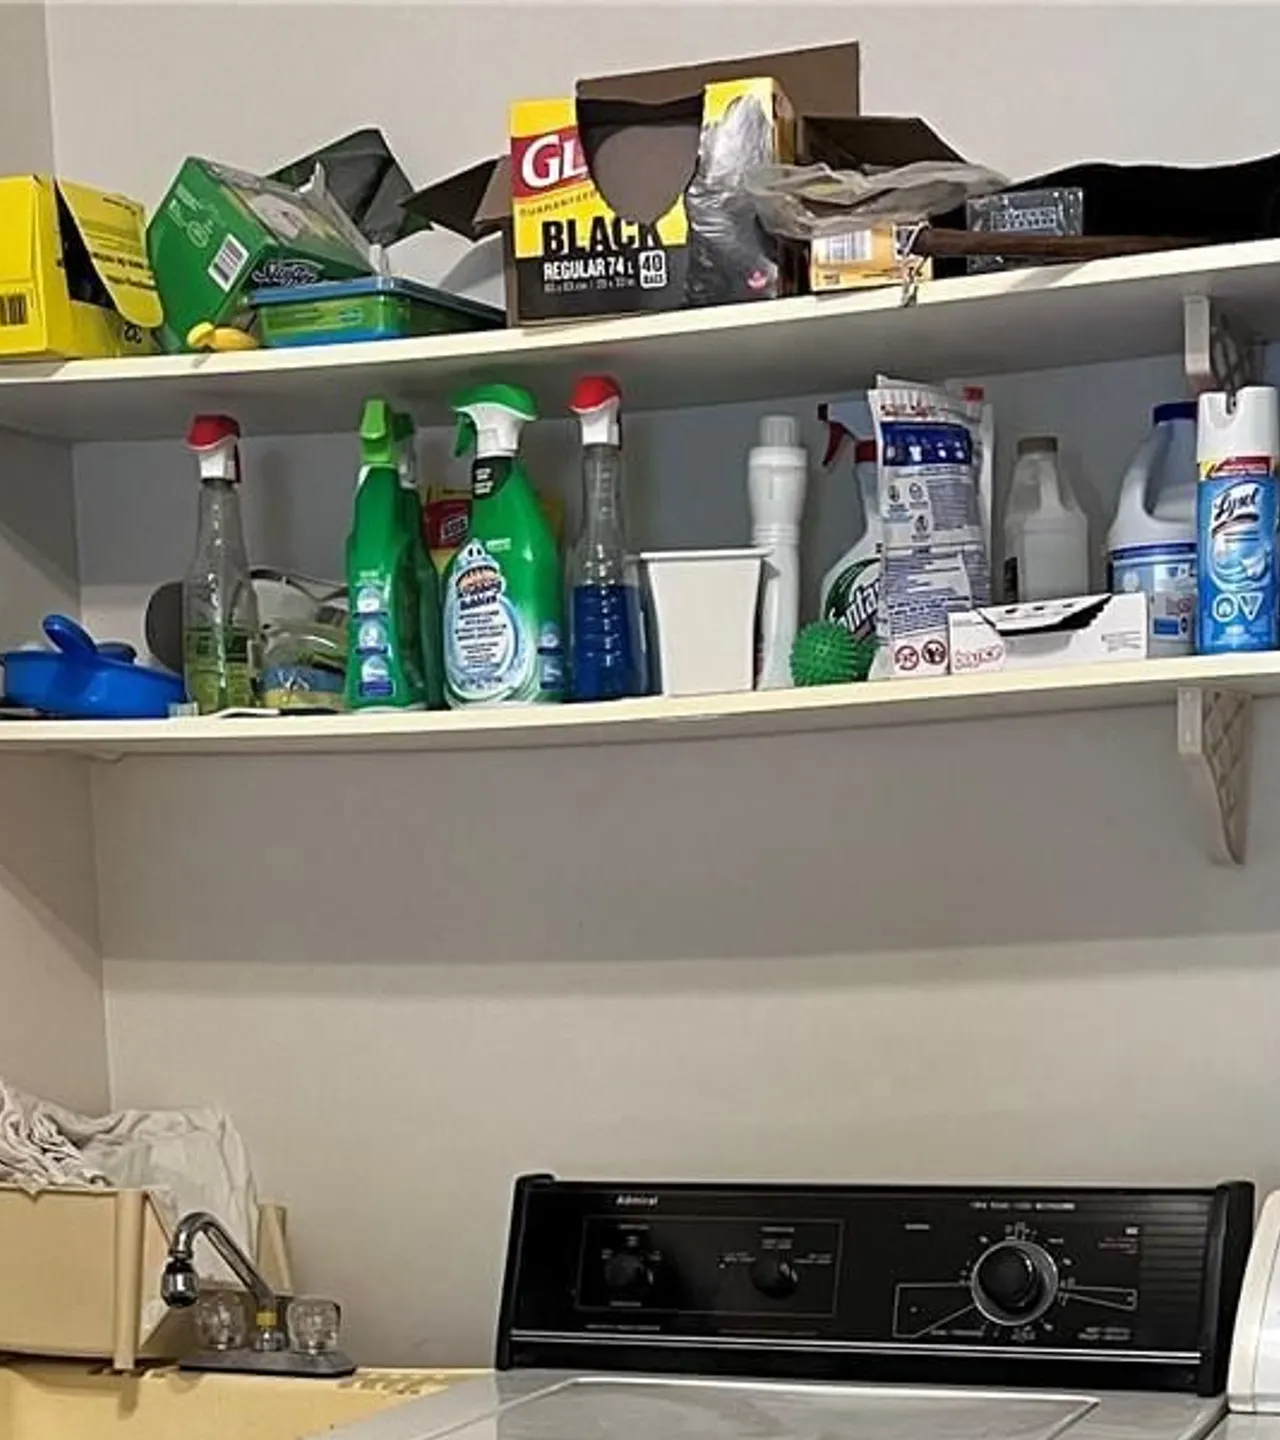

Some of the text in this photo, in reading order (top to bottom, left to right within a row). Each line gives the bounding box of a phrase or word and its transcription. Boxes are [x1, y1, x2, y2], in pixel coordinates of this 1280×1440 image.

[522, 134, 589, 189] GL
[544, 258, 606, 282] REGULAR
[608, 255, 625, 277] 74
[642, 253, 663, 273] 40
